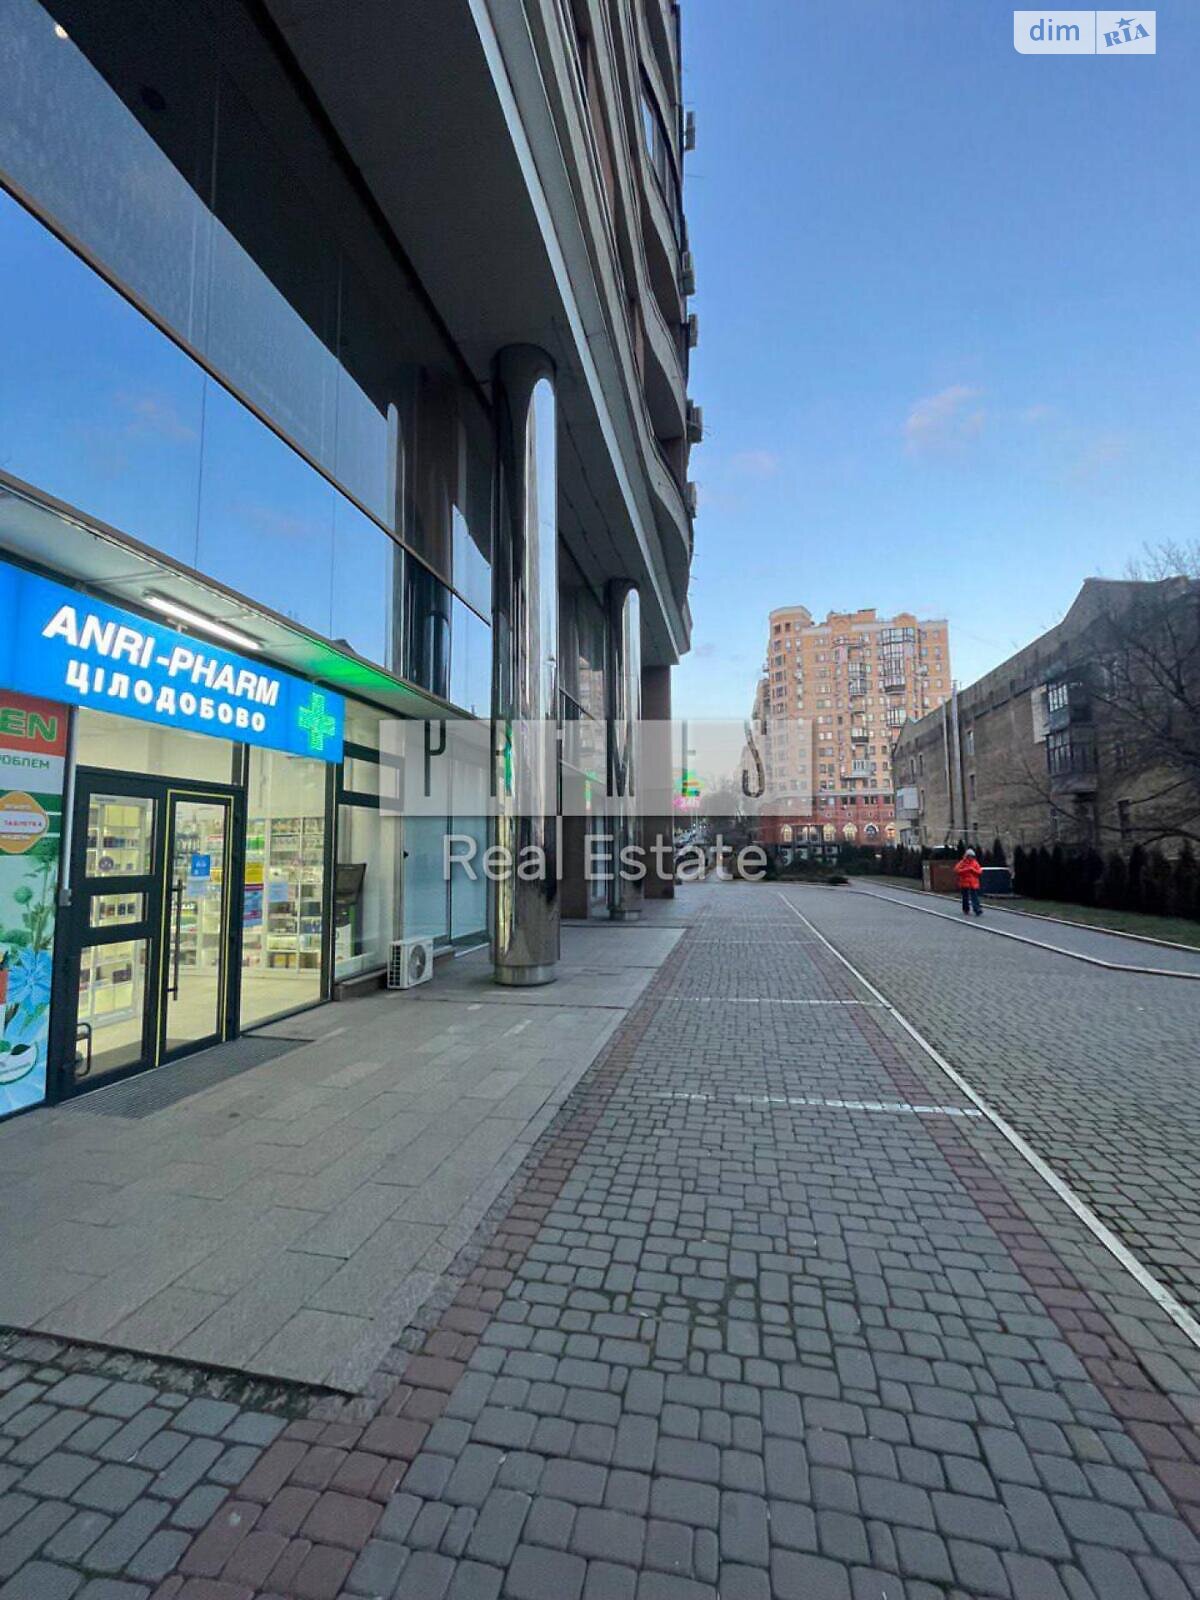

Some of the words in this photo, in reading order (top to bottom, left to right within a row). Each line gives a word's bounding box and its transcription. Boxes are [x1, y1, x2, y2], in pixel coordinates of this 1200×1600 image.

[42, 605, 281, 706] ANRI-PHARM
[65, 660, 266, 732] ЦІЛОДОБОВО
[0, 754, 50, 769] ОБЛЕМ
